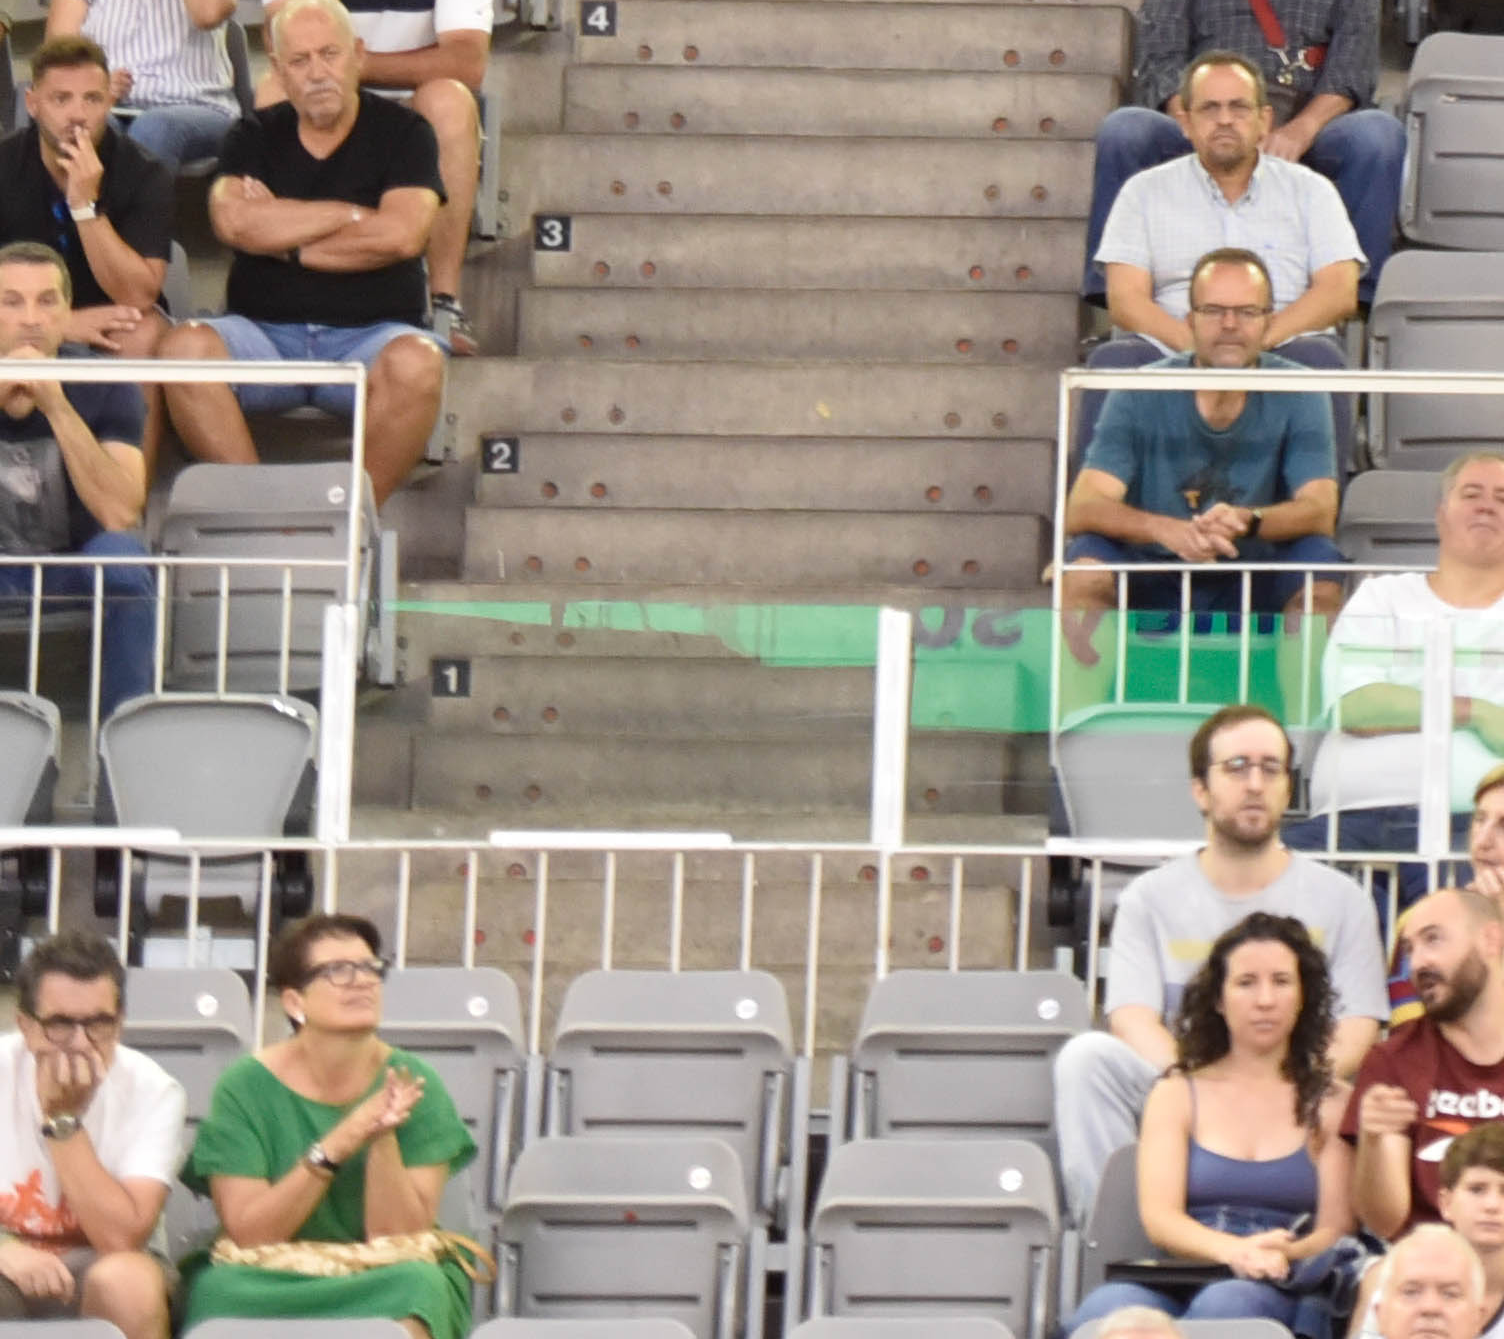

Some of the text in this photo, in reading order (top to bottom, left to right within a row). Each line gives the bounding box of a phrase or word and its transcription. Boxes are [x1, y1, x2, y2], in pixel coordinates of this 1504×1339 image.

[587, 5, 610, 32] 4
[540, 219, 563, 247] 3
[490, 442, 512, 470] 2
[441, 665, 458, 694] 1
